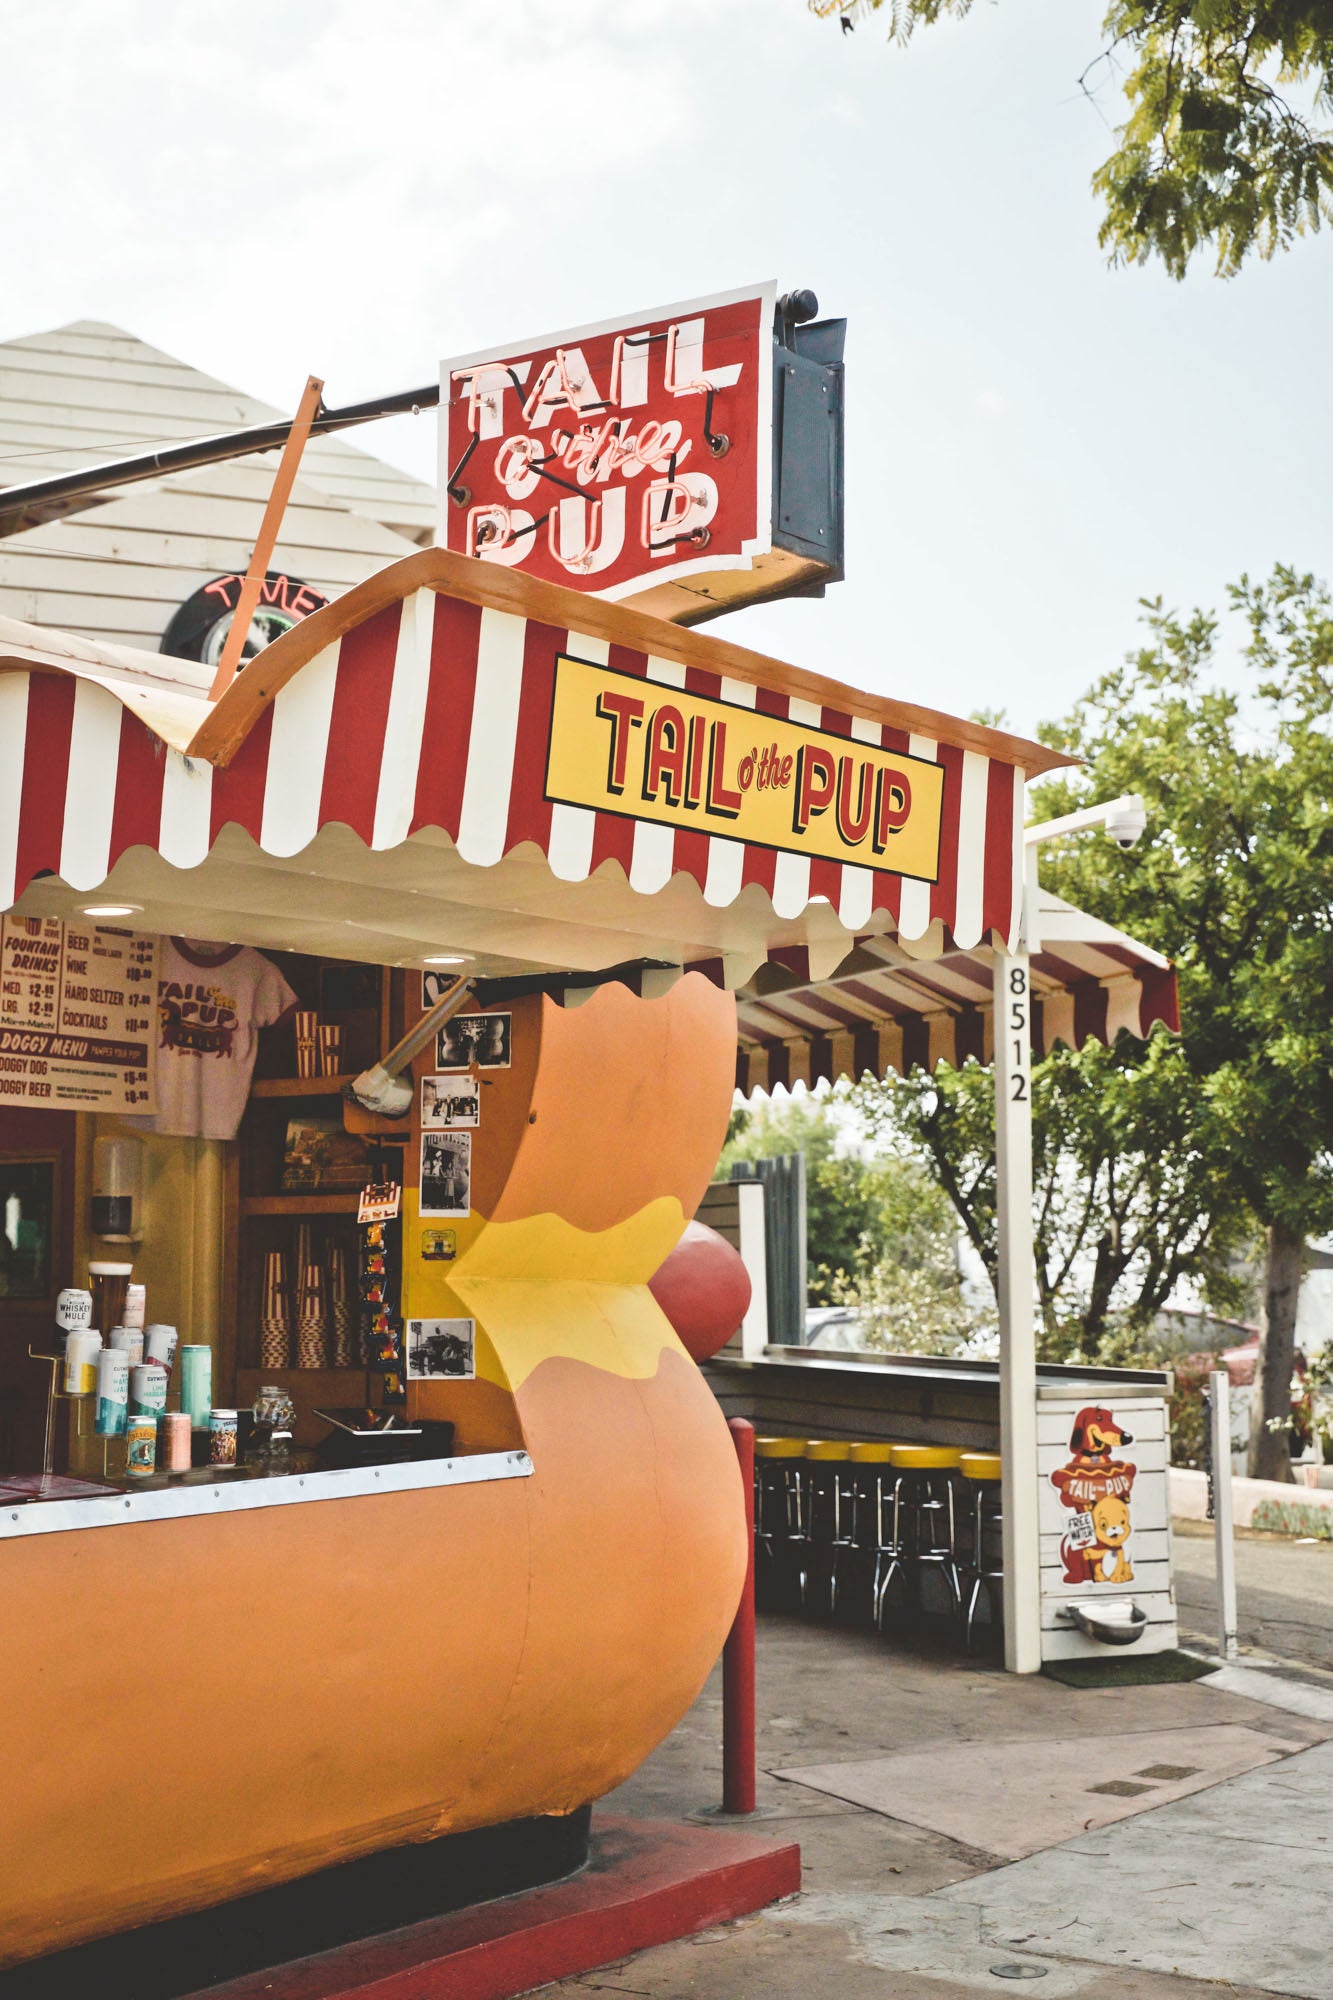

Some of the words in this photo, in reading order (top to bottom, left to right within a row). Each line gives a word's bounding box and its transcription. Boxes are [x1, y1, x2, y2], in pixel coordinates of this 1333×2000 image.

[451, 317, 744, 441] TAIL
[466, 471, 719, 575] PUP
[596, 690, 743, 820] TAIL
[792, 743, 913, 855] PUP
[5, 936, 61, 957] FOUNTAIN
[67, 934, 89, 952] BEER
[11, 954, 59, 973] DRINKS
[67, 959, 88, 975] WINE
[65, 984, 88, 1002] HARD
[89, 987, 124, 1007] SELTZER
[63, 1010, 108, 1031] COCKTAILS
[181, 1001, 235, 1025] PUP
[1009, 967, 1028, 1101] 8512
[1, 1033, 48, 1053] DOGGY
[50, 1038, 88, 1058] MENU
[30, 1060, 48, 1076] DOG
[29, 1082, 52, 1098] BEER
[60, 1303, 90, 1312] WHISKEY
[64, 1312, 86, 1320] MULE
[1069, 1478, 1096, 1501] TAIL
[1105, 1475, 1129, 1496] PUP
[1068, 1513, 1091, 1527] FREE
